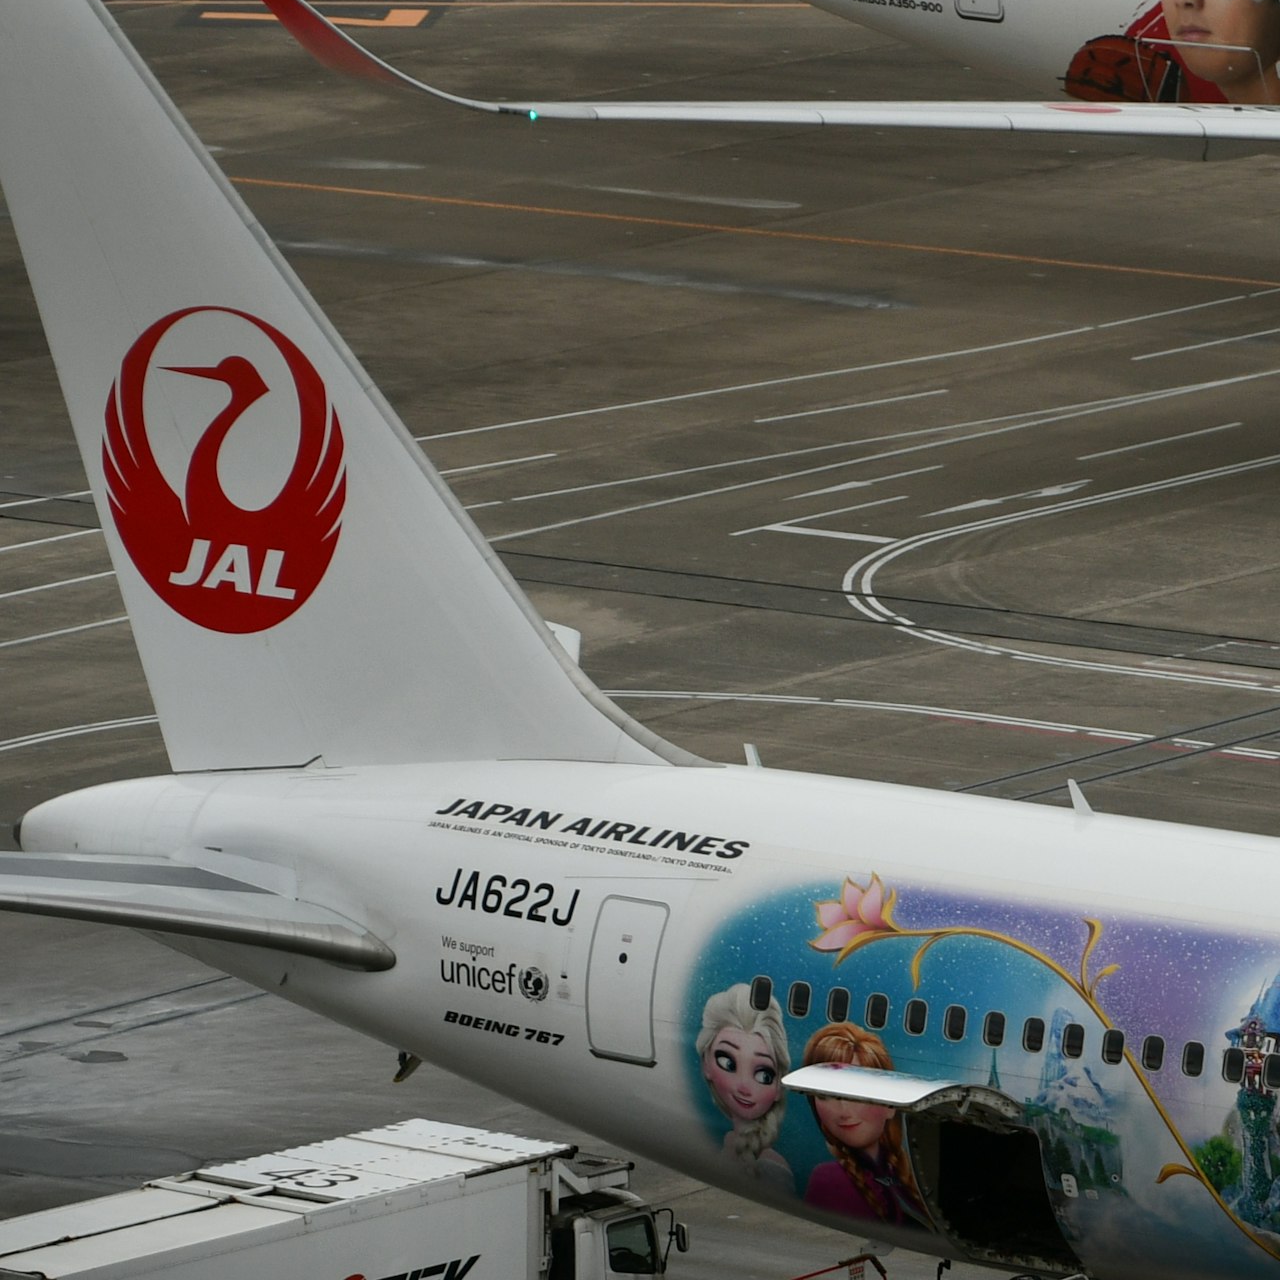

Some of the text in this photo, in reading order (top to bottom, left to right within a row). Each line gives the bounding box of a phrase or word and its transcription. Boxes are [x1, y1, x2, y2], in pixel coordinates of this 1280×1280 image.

[168, 538, 296, 600] JAL
[427, 821, 451, 830] JAPAN
[452, 823, 482, 836] AIRLINES
[491, 830, 502, 838] AN
[503, 832, 533, 843] OFFICIAL
[534, 837, 569, 848] SPONSOR
[569, 842, 580, 850] OF
[581, 844, 607, 854] TOKYO
[661, 856, 687, 867] TOKYO
[435, 798, 750, 859] JAPAN AIRLINES
[436, 868, 580, 926] JA622J
[441, 935, 495, 958] We support
[440, 956, 517, 995] unicef
[443, 1010, 565, 1046] BOEING 767
